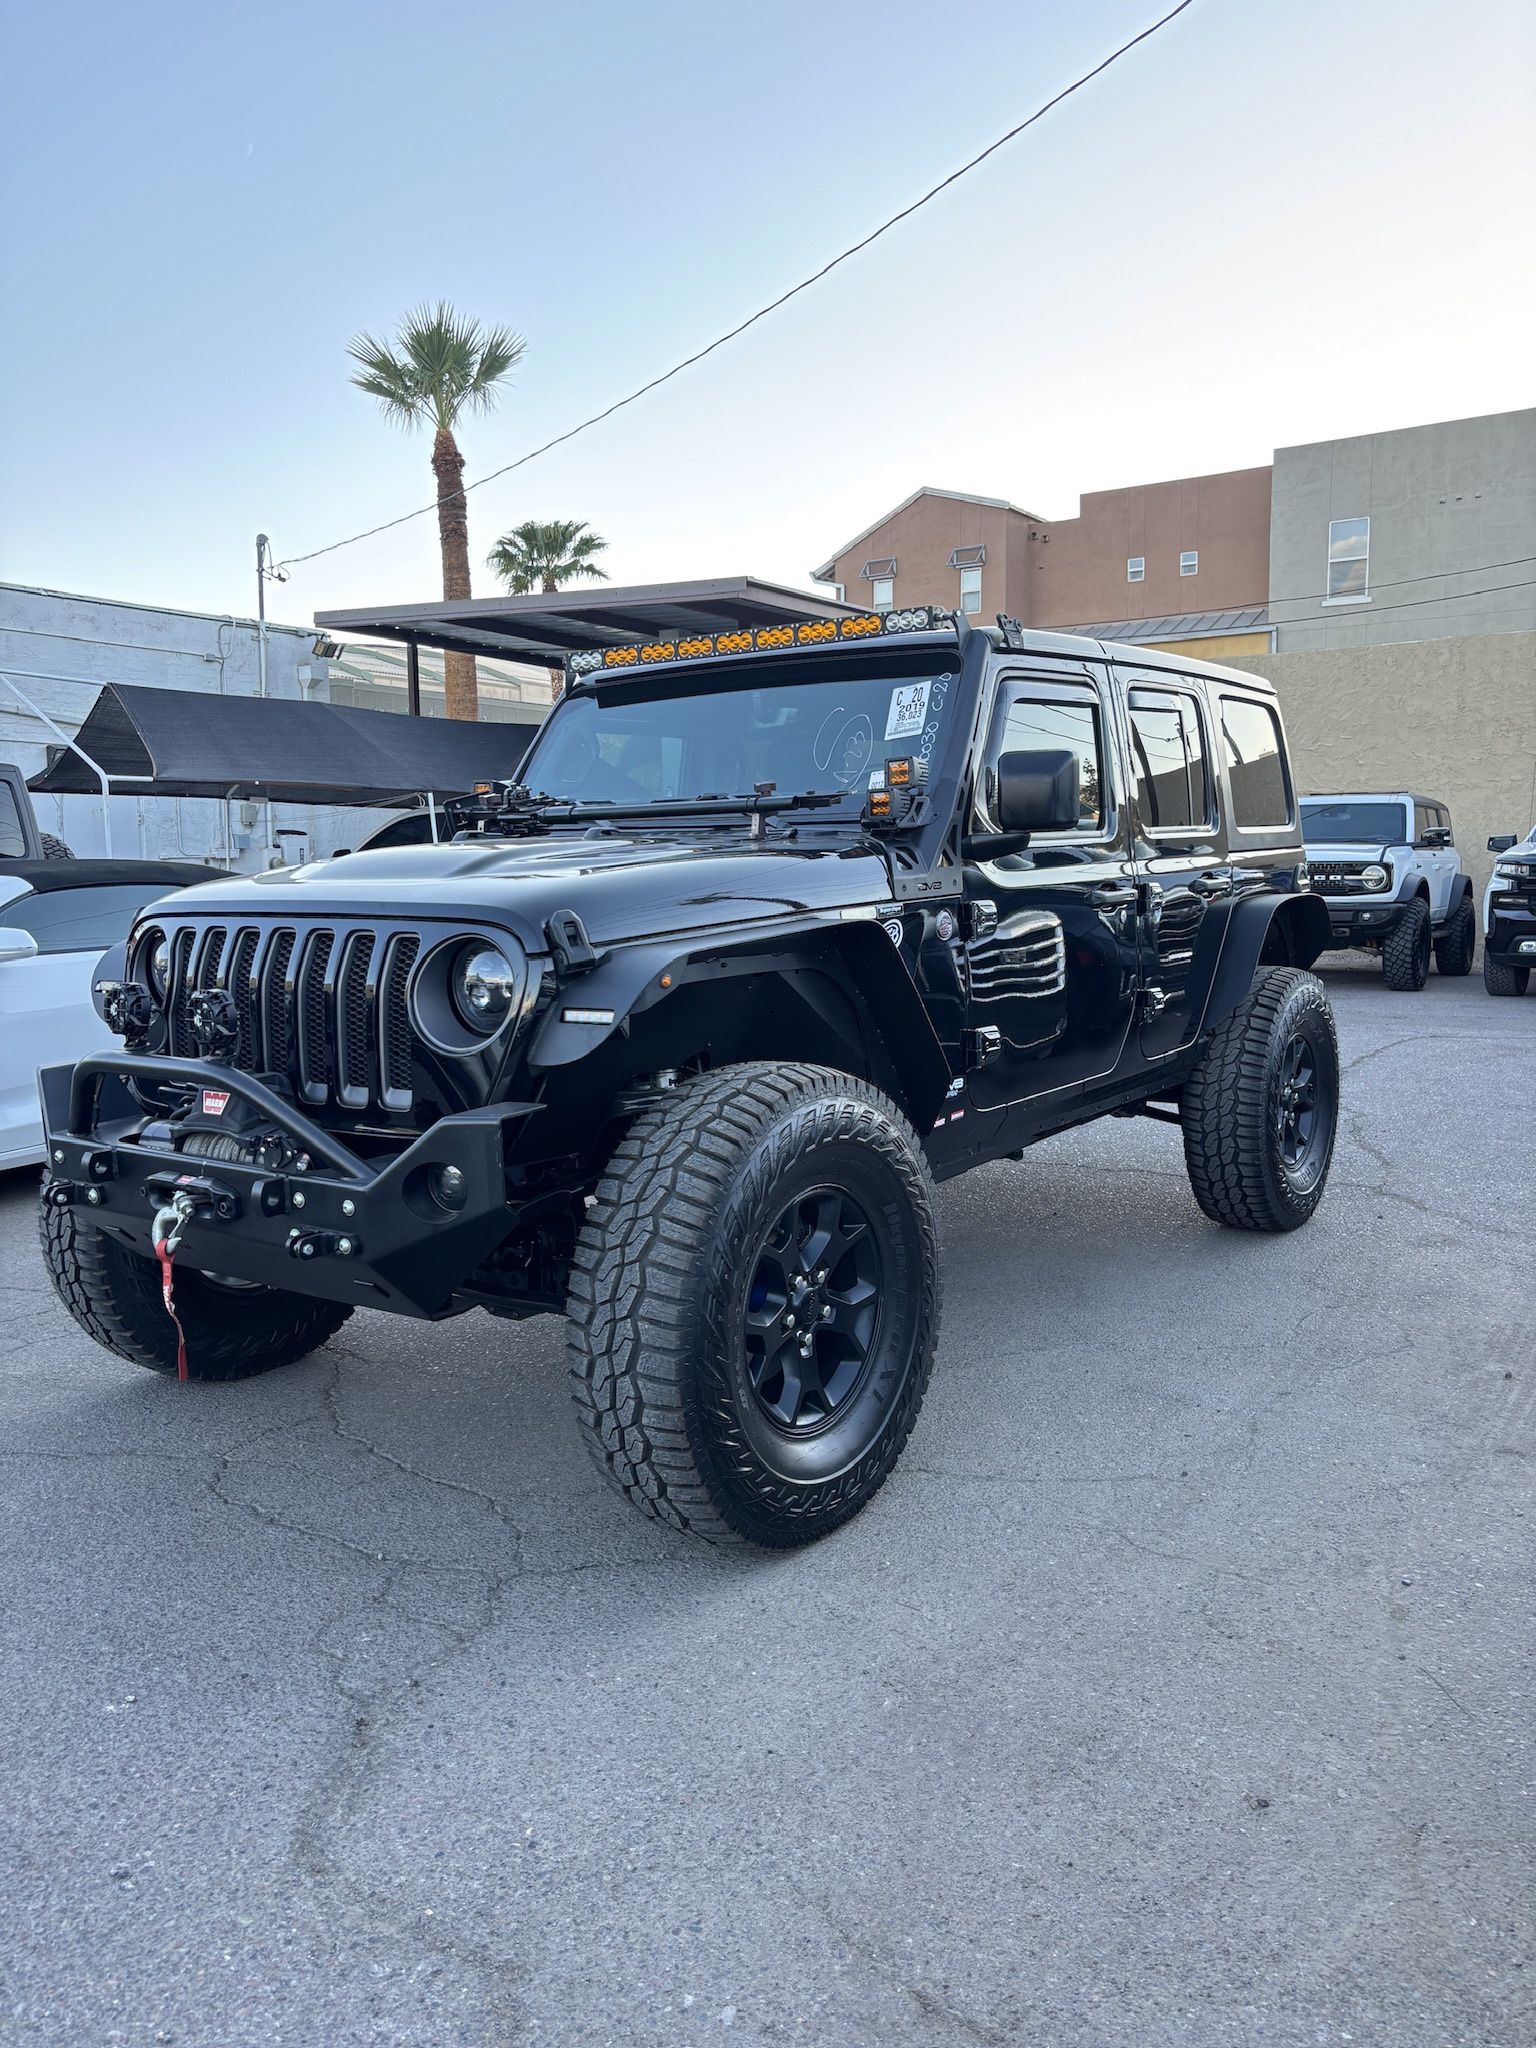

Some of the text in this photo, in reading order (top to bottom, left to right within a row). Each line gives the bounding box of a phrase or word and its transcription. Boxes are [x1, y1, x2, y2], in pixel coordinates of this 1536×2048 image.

[896, 686, 924, 706] C 20
[898, 701, 926, 714] 2019
